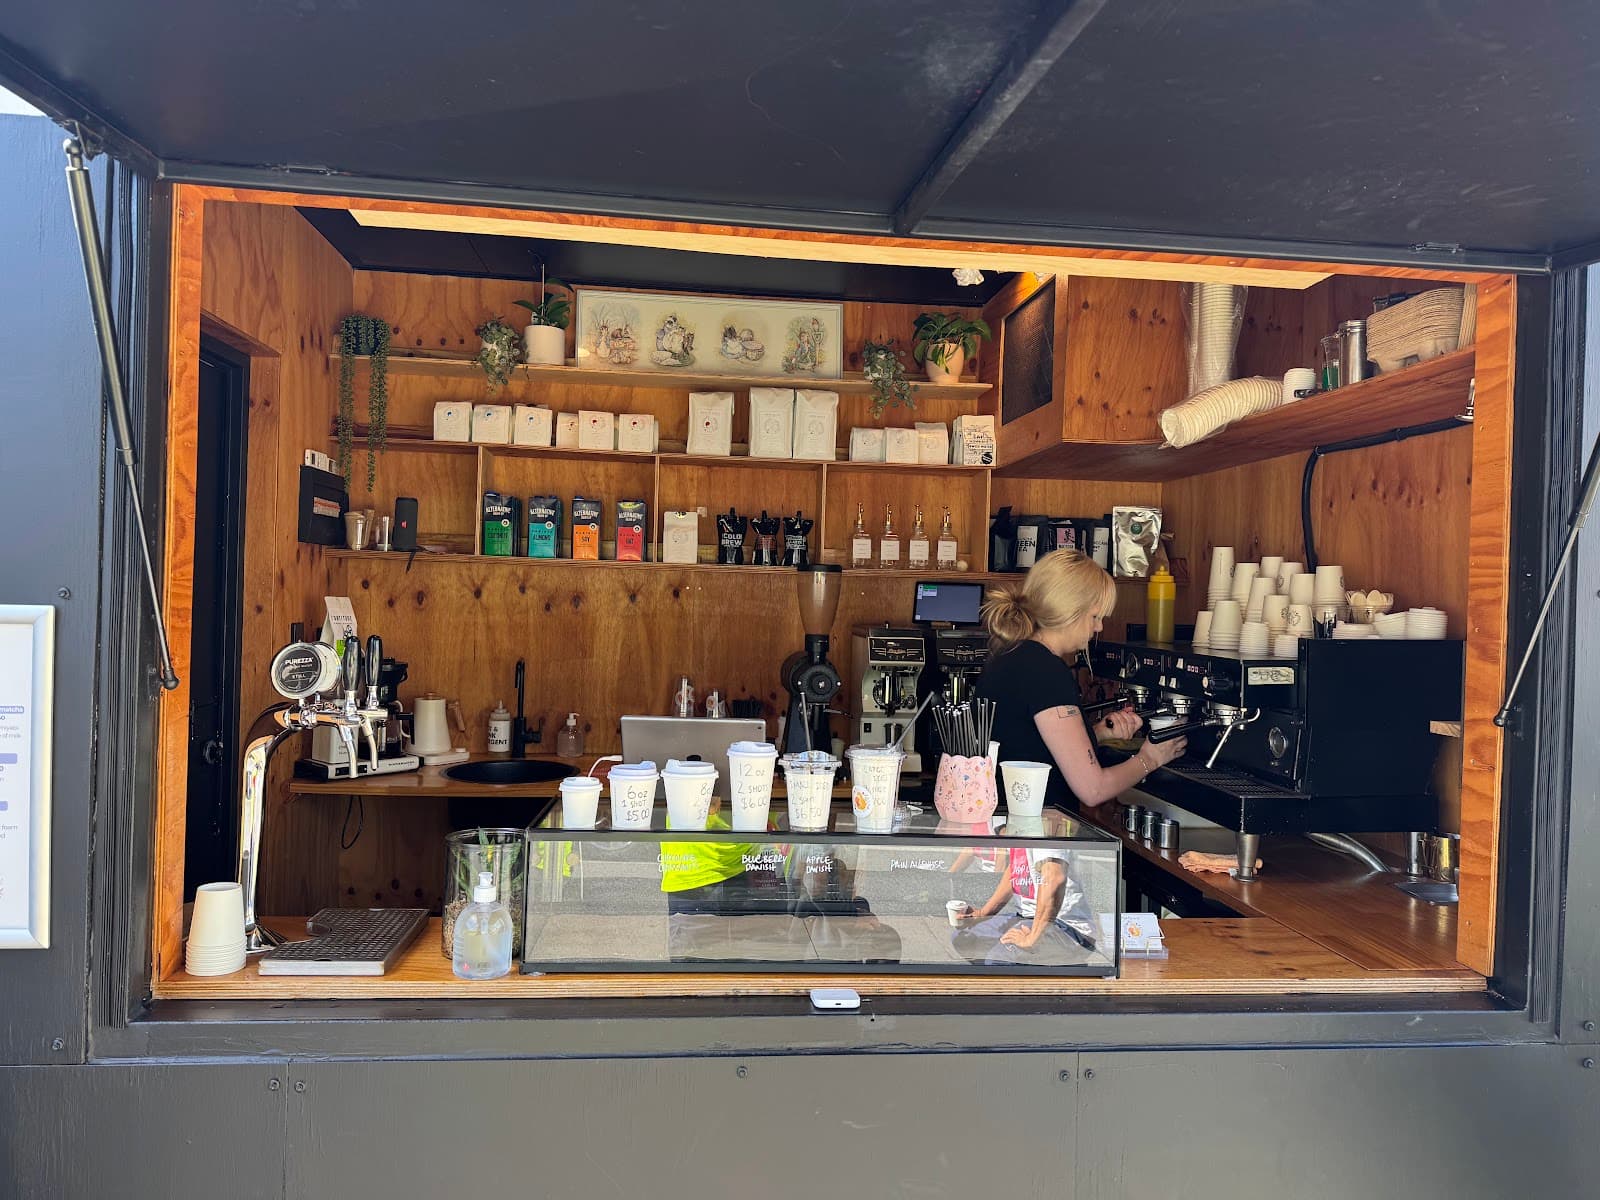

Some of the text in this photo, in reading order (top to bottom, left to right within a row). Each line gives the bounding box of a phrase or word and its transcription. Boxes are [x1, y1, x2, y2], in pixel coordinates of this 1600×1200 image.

[285, 657, 312, 665] PUREZZA
[739, 763, 752, 776] 12
[630, 799, 647, 808] SHOT
[806, 855, 833, 865] APPLE
[745, 862, 777, 872] DANISH
